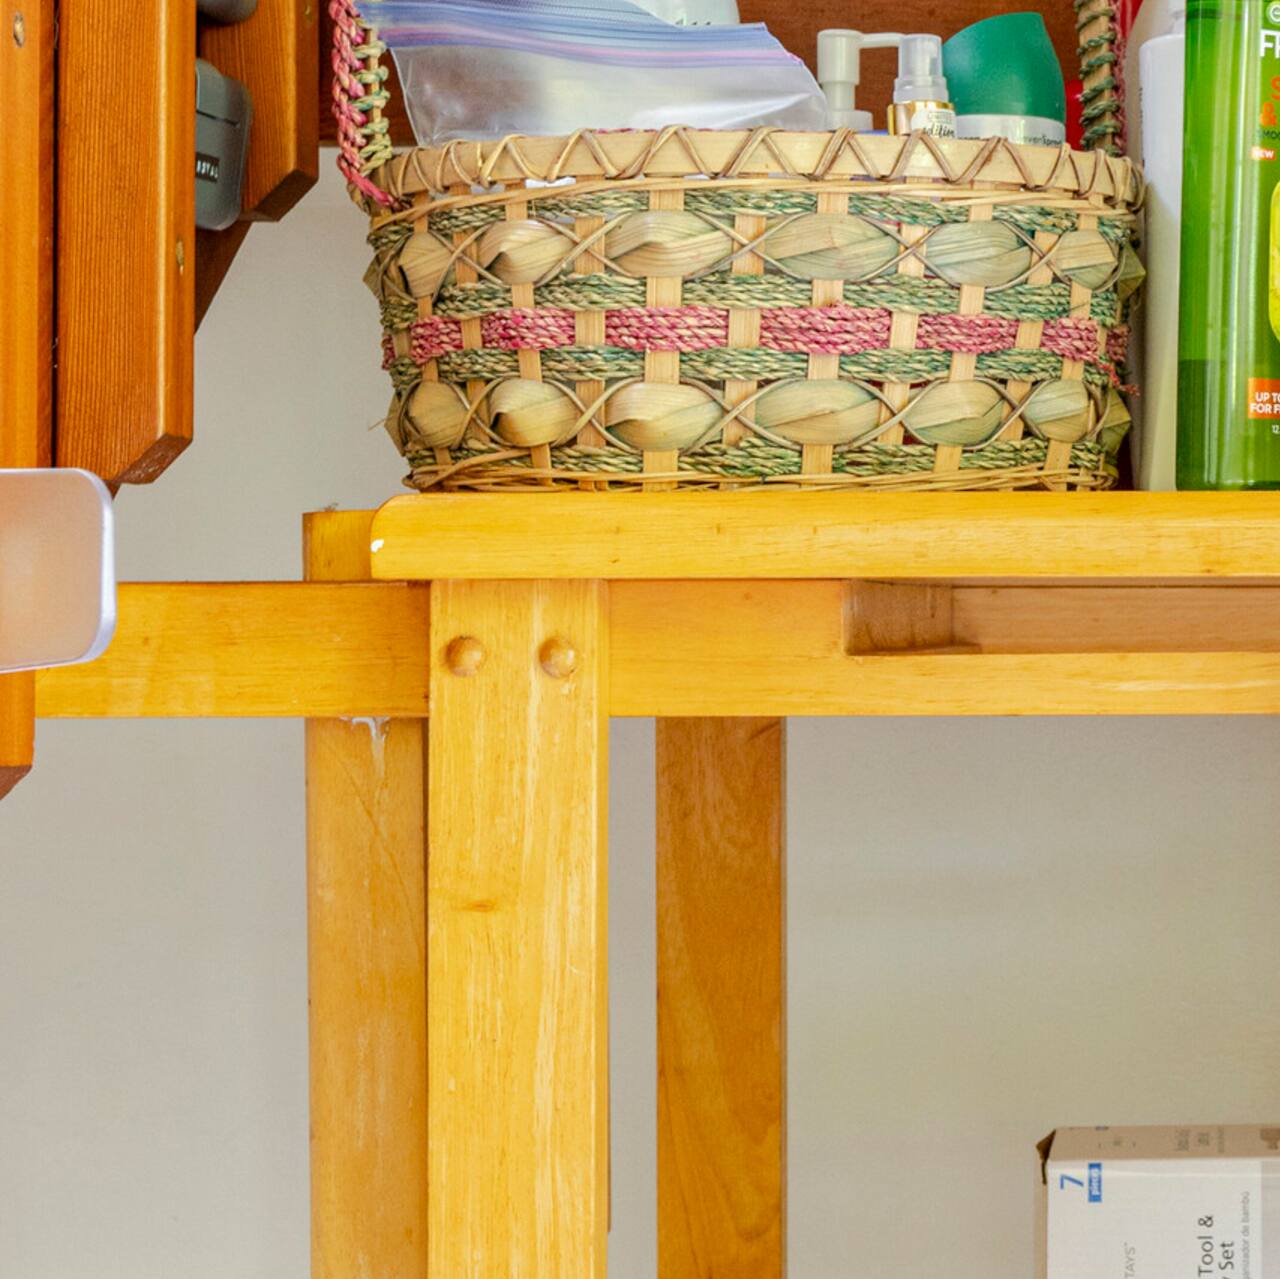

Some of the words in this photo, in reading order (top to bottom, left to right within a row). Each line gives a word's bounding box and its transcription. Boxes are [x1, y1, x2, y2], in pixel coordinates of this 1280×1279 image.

[1260, 102, 1276, 126] &
[1256, 392, 1270, 402] UP
[1250, 403, 1272, 414] FOR
[1060, 1175, 1084, 1190] 7
[1198, 1215, 1214, 1228] &
[1198, 1236, 1214, 1277] Tool
[1219, 1241, 1235, 1271] Set
